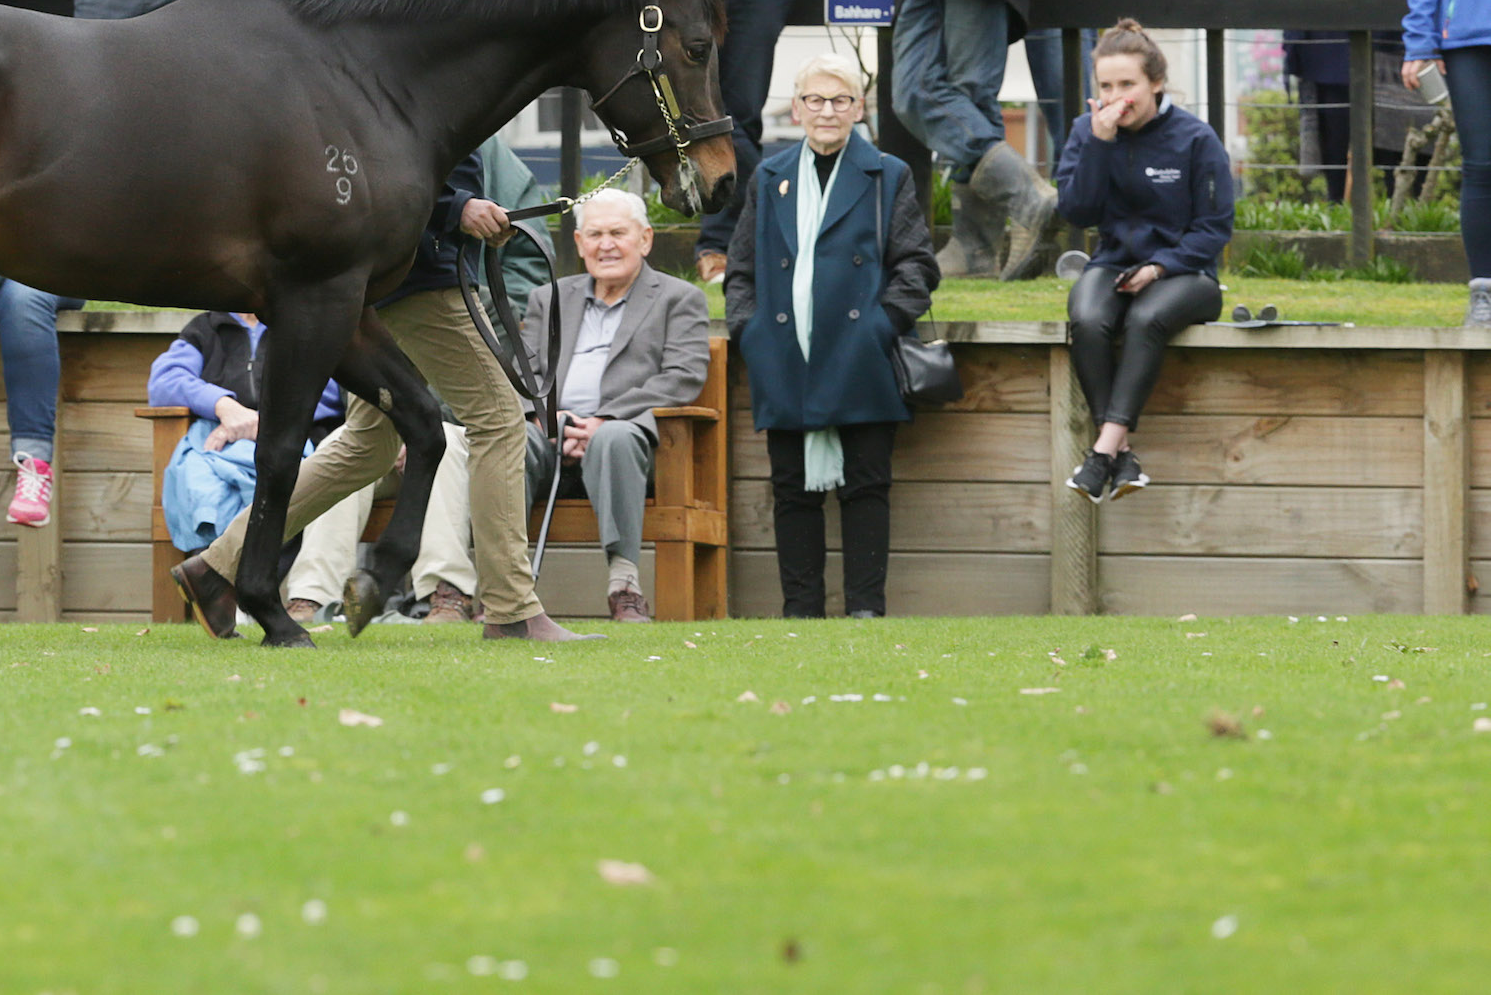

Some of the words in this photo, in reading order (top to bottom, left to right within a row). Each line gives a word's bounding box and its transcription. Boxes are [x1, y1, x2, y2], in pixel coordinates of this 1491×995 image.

[834, 5, 882, 19] Bahhare
[324, 145, 358, 175] 26
[336, 176, 352, 205] 9
